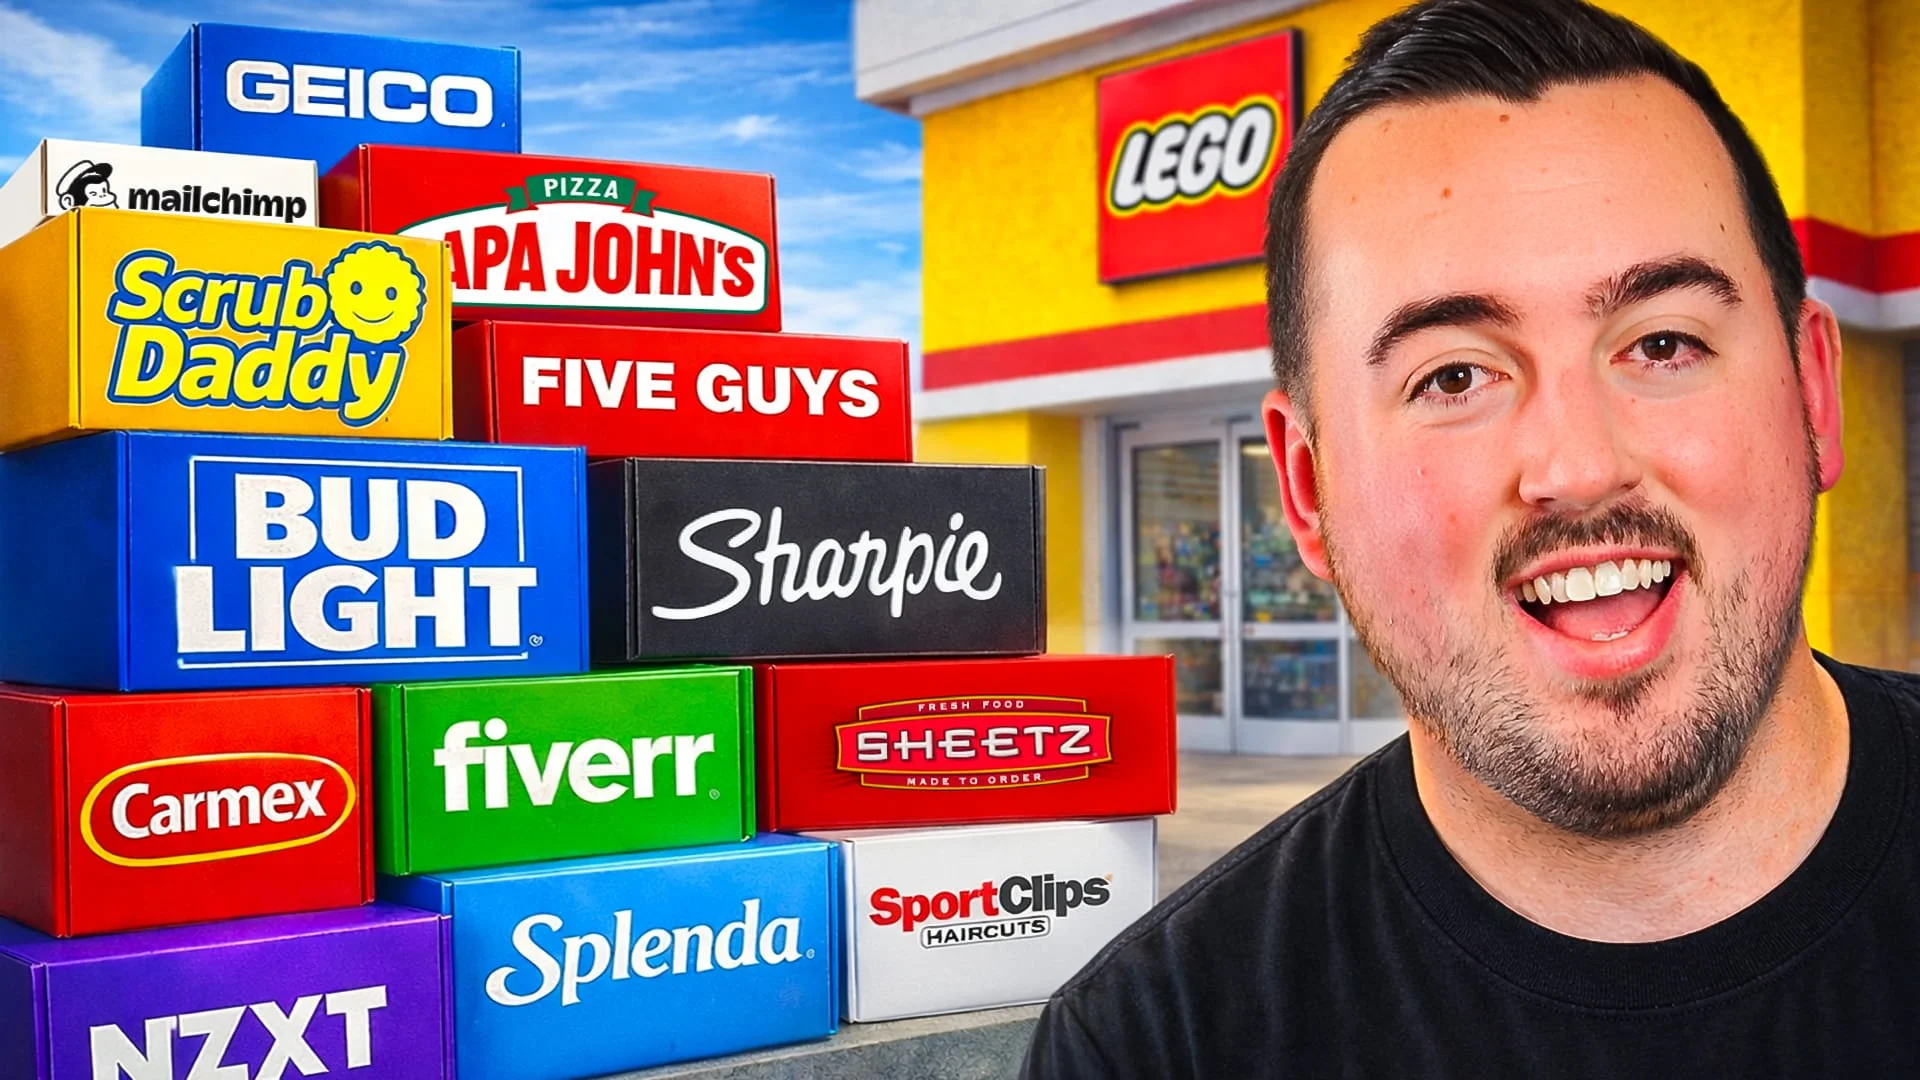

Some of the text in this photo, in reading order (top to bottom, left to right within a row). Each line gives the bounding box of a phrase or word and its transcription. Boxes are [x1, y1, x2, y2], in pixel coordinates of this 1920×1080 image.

[226, 60, 494, 128] GEICO
[543, 177, 619, 200] PIZZA
[1111, 103, 1276, 210] LEGO
[128, 185, 307, 222] mailchimp
[111, 255, 331, 331] Scrub
[445, 221, 755, 298] APA JOHN'S
[112, 324, 404, 421] Daddy
[522, 356, 880, 418] FIVE GUYS
[234, 473, 486, 562] BUD
[651, 506, 1002, 620] Sharpie
[175, 564, 538, 654] LIGHT
[857, 724, 1091, 761] SHEETZ
[918, 700, 1025, 712] FRESH FOOD
[433, 717, 715, 812] fiverr
[906, 773, 1042, 787] MADE TO ORDER
[111, 778, 326, 839] Carmex
[485, 898, 803, 1008] Splenda
[926, 919, 1046, 946] HAIRCUTS
[90, 985, 387, 1080] NZXT
